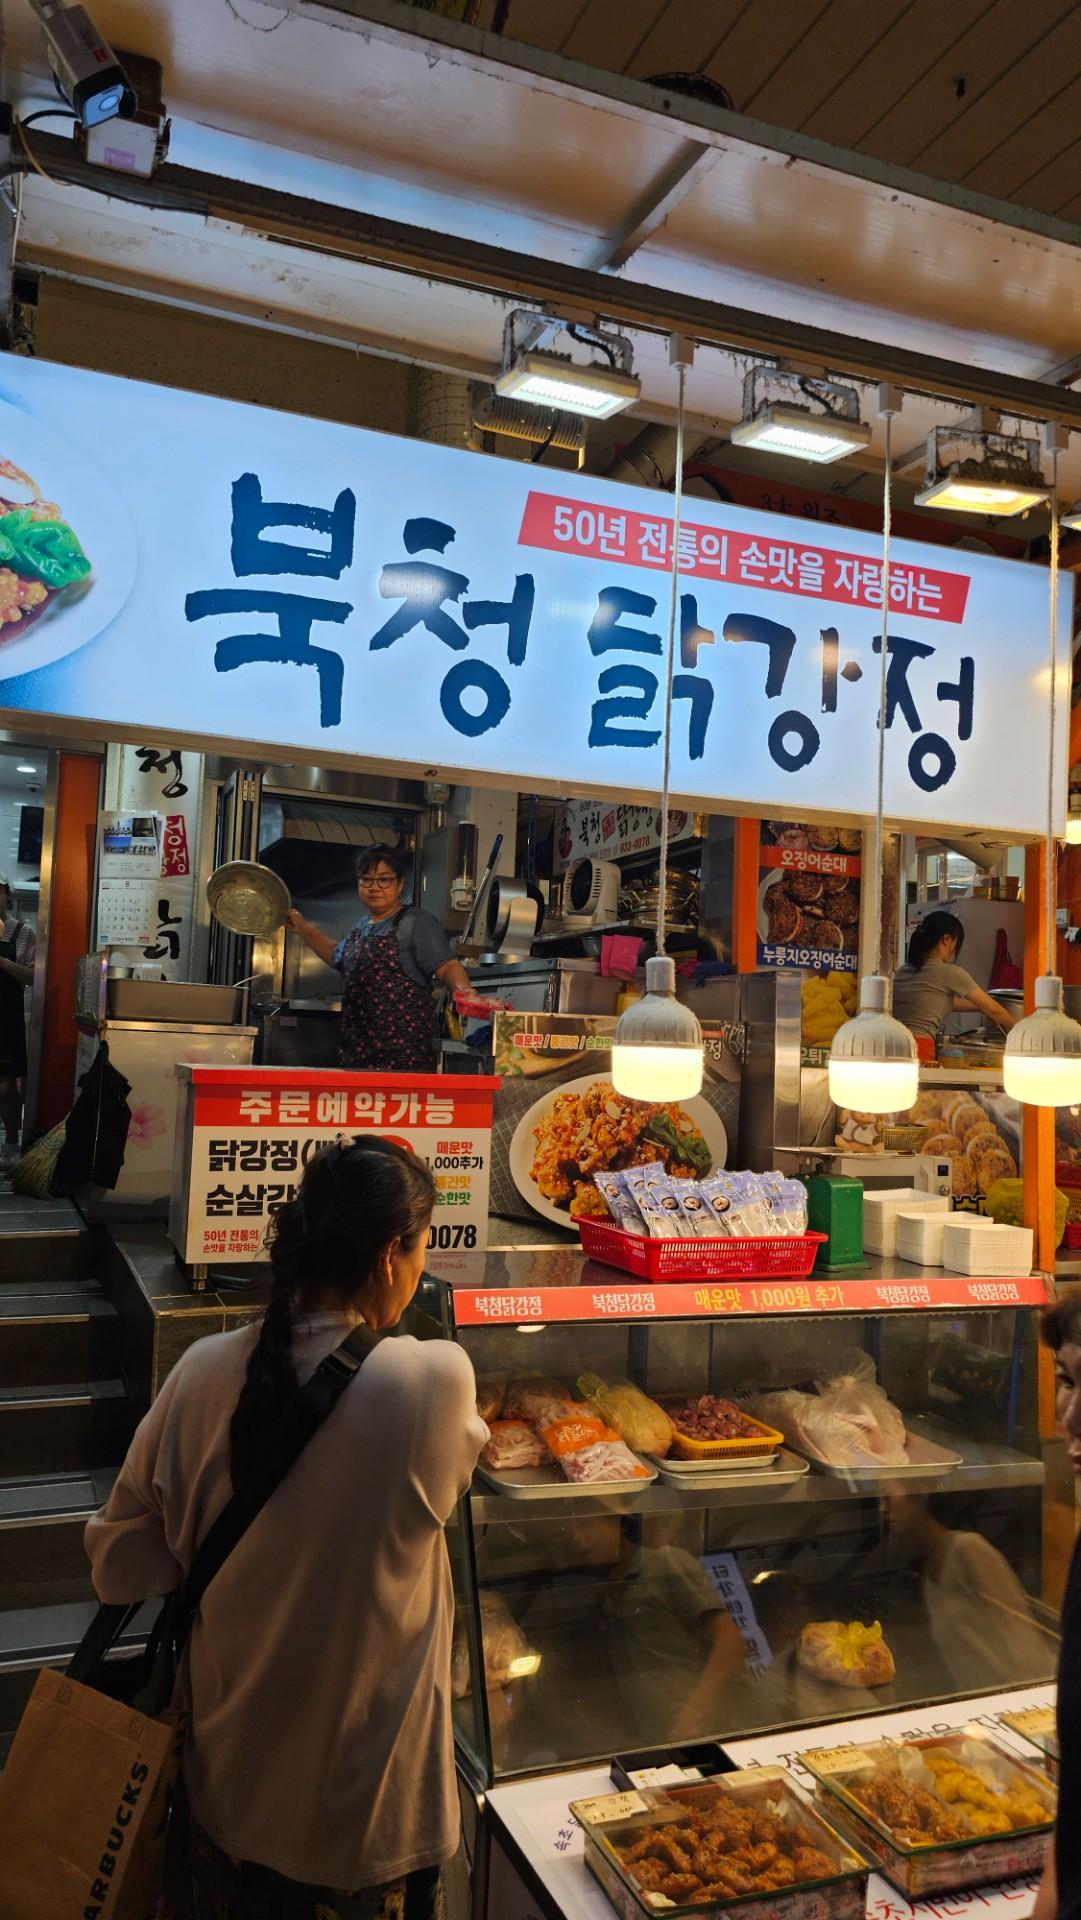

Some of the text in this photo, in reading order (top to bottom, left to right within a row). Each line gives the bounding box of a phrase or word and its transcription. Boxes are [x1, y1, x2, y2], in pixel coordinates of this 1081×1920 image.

[553, 505, 943, 614] 50년 전통의 손맛을 자랑하는
[185, 472, 975, 793] 북청 닭강정
[781, 850, 848, 873] 오징어순대
[763, 945, 858, 970] 누룽지오징어순대
[239, 1090, 455, 1125] 주문예약가능
[436, 1141, 474, 1155] 매운맛
[203, 1229, 259, 1242] 50년 전통의
[203, 1242, 257, 1253] 손맛을 자랑하는
[475, 1283, 1020, 1317] 북청닭강정 북청닭강정 매운맛 1,000원 추가 북청닭강정 북청닭강정
